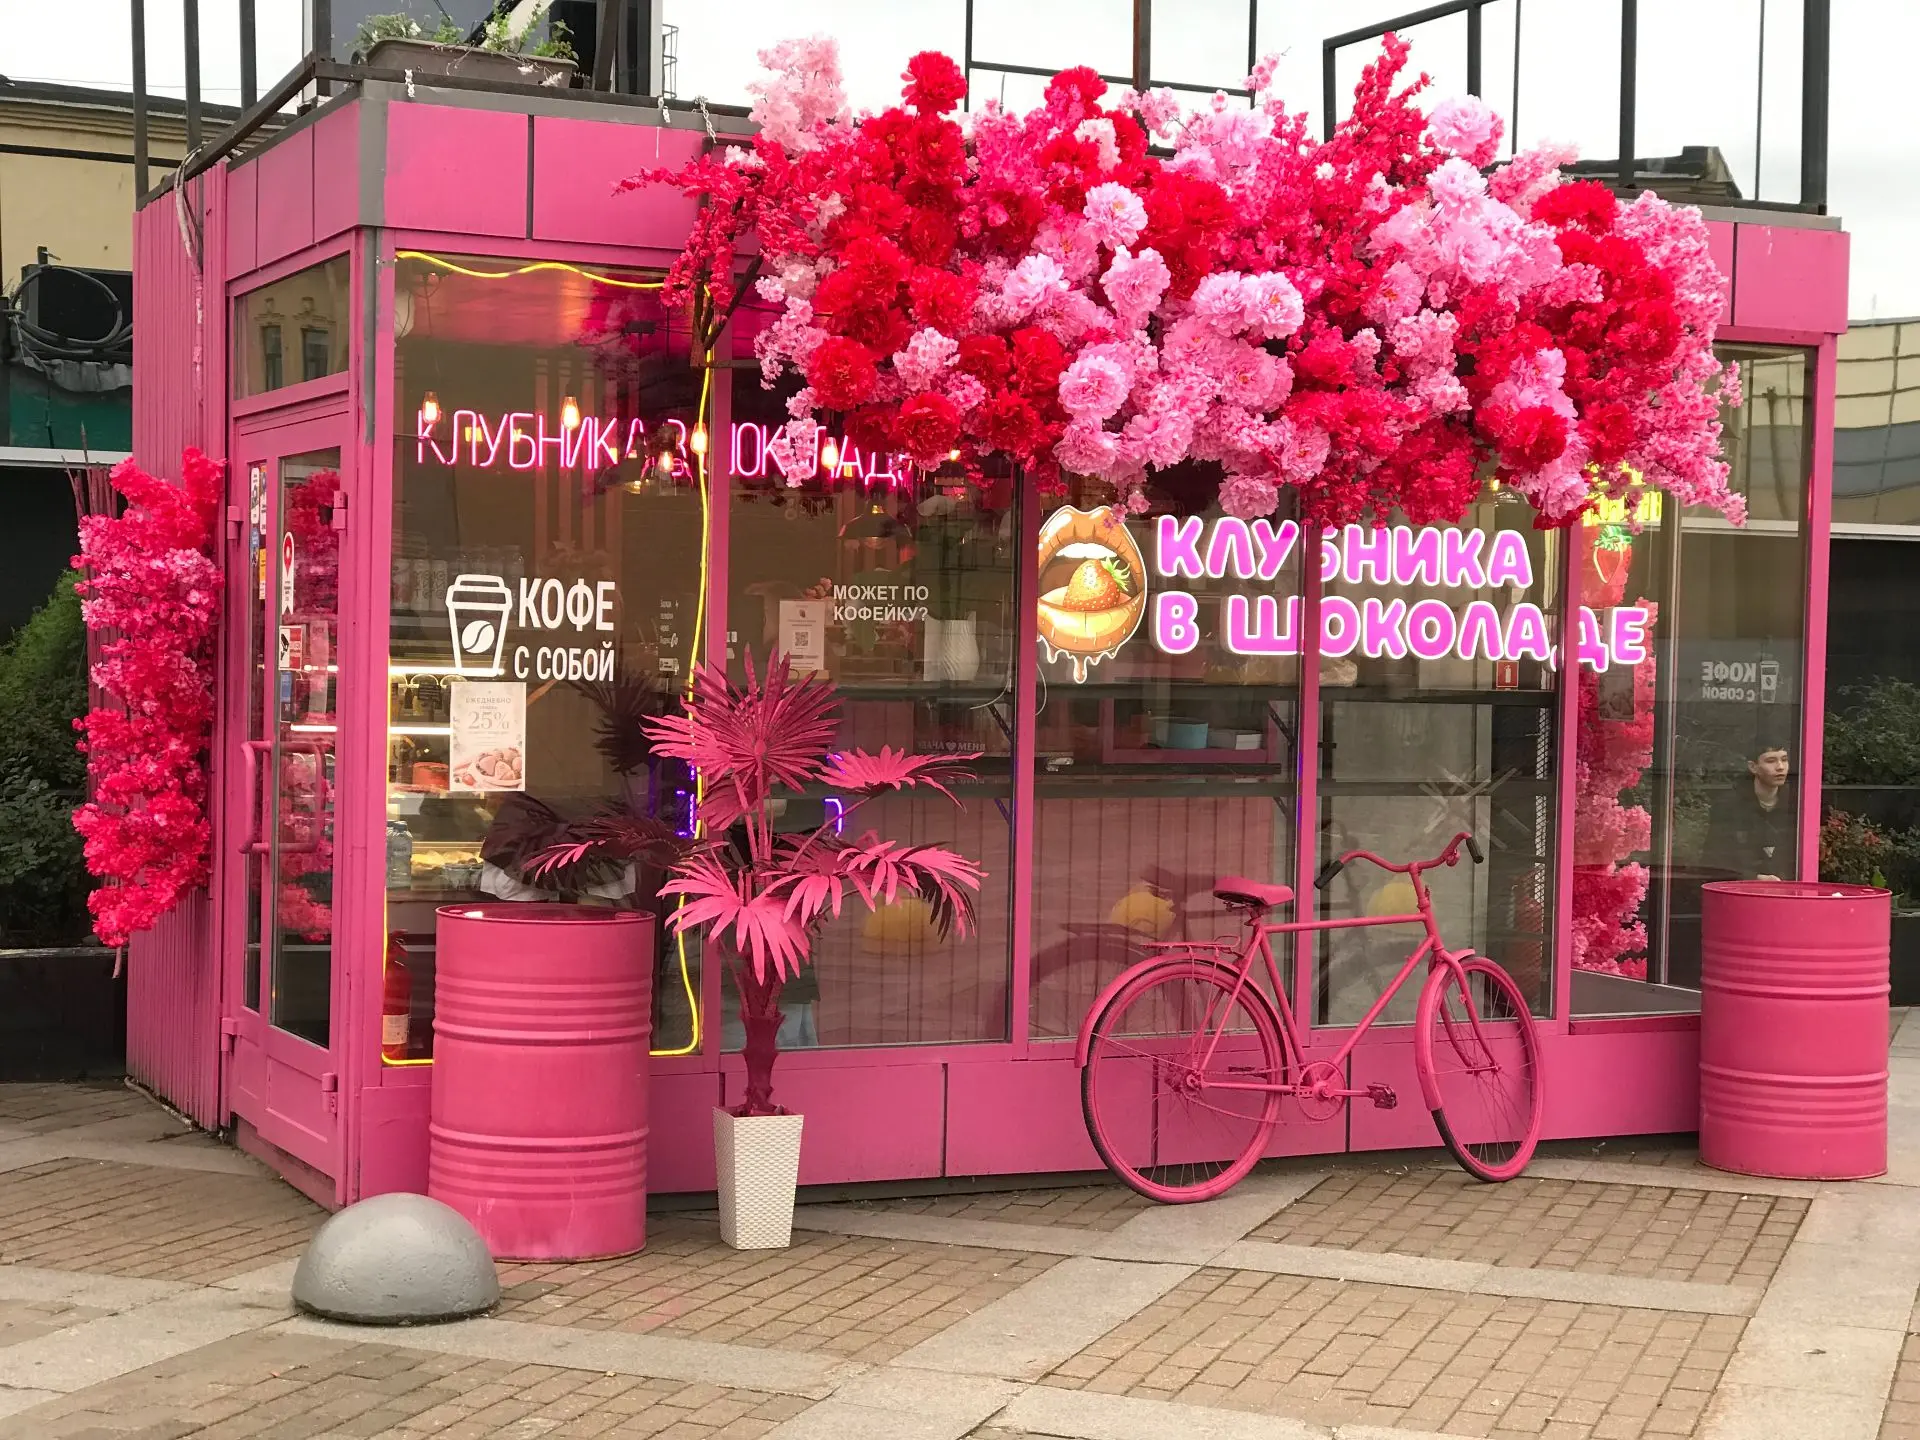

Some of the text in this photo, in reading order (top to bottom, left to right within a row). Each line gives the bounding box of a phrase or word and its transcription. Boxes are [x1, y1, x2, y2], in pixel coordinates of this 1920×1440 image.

[700, 420, 908, 487] ОКЛАД
[518, 577, 616, 632] КОФЕ
[833, 584, 929, 601] МОЖЕТ ПО
[833, 603, 929, 622] КОФЕЙКУ?
[1155, 590, 1649, 674] В ШОКОЛАДЕ
[514, 640, 615, 682] С СОБОЙ
[467, 711, 510, 730] 25%
